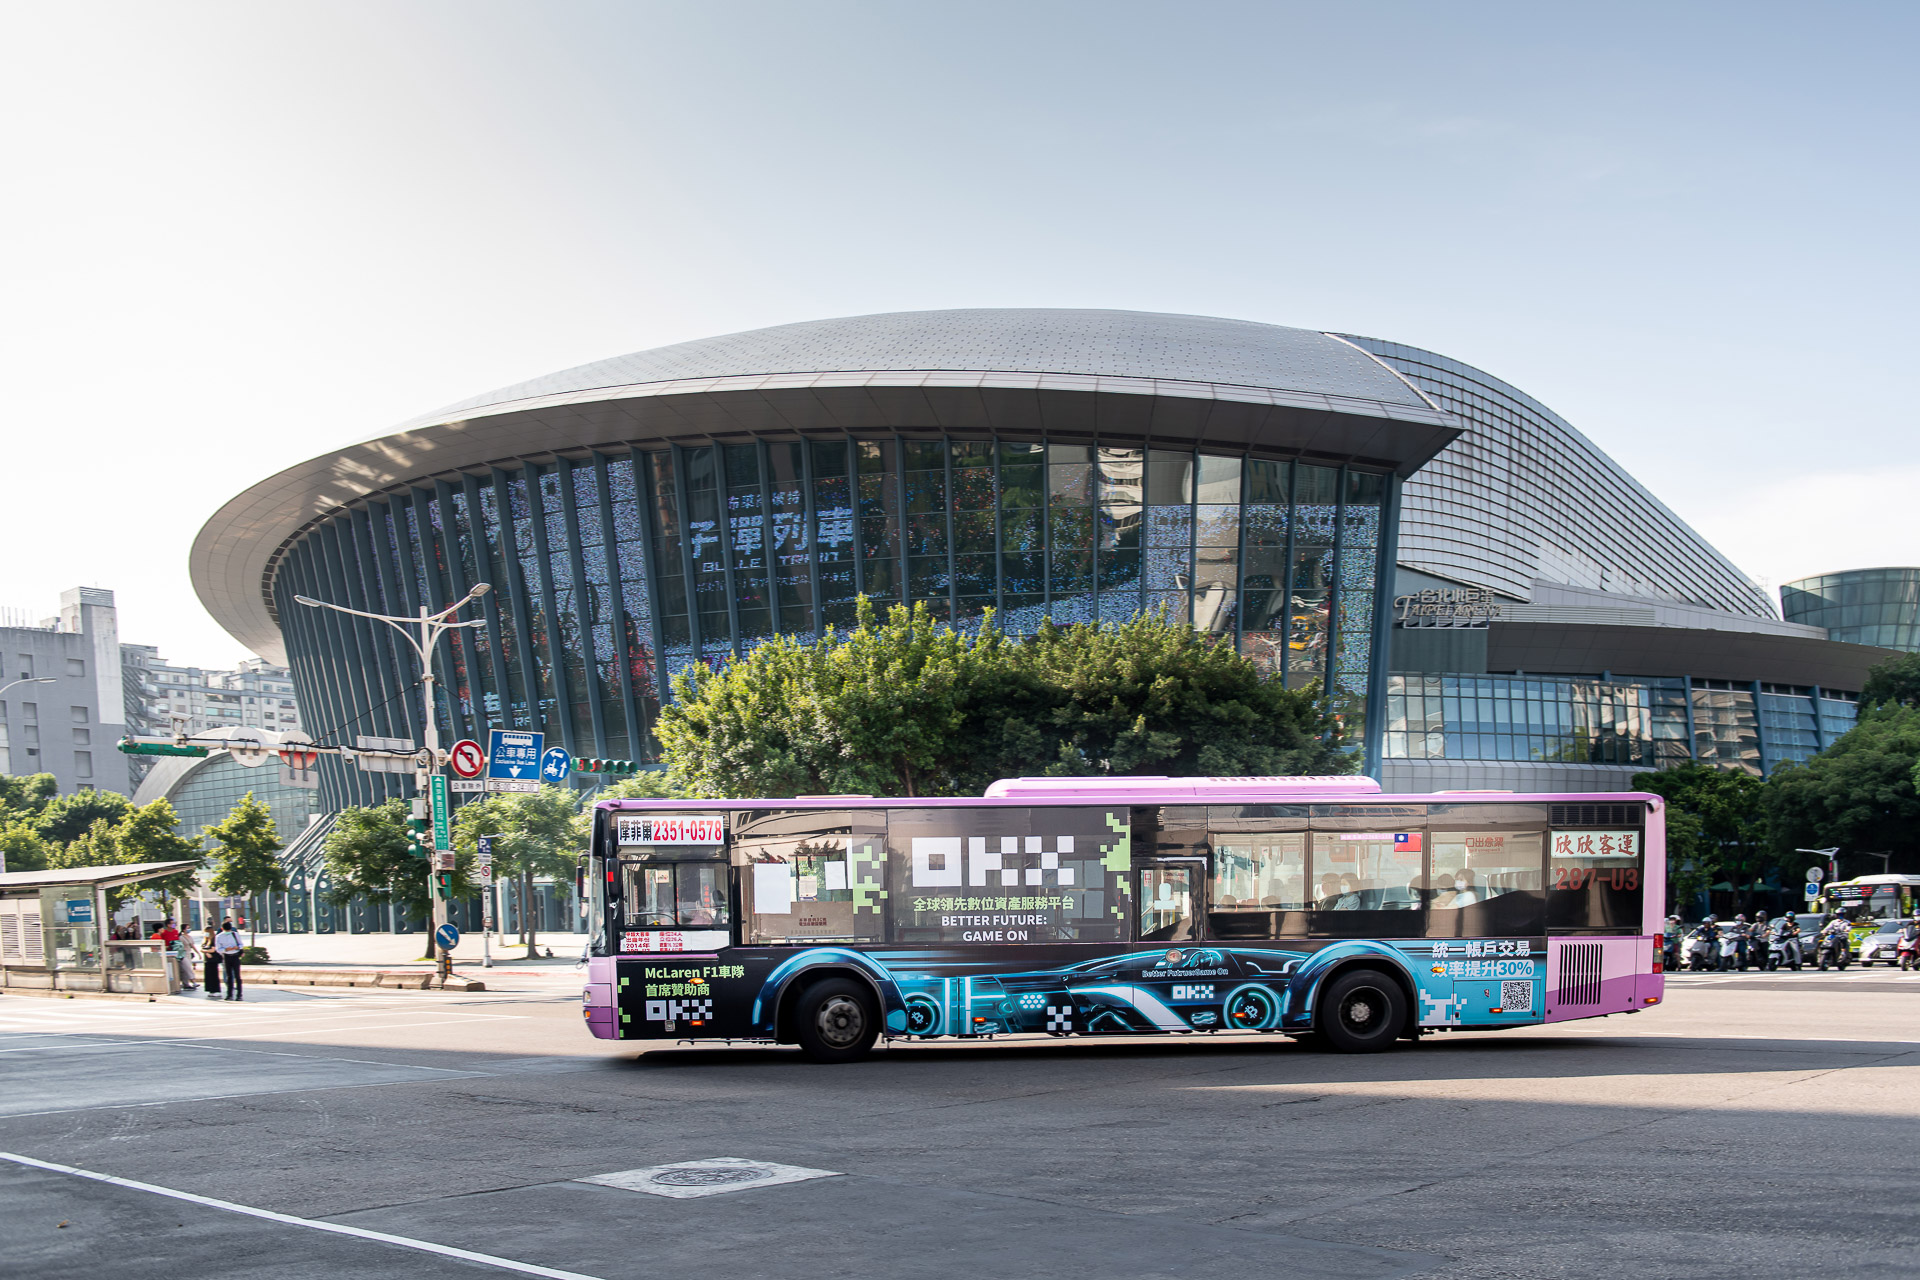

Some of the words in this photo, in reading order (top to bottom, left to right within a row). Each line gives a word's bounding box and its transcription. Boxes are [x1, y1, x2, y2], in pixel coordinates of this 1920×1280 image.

[495, 746, 537, 759] 公車專用
[1555, 834, 1635, 856] 欣欣客運
[912, 835, 1075, 887] OKX
[1556, 867, 1638, 891] 287-U3
[913, 896, 1075, 912] 全球領先數位資產服務平台
[941, 915, 990, 927] BETTER
[993, 914, 1048, 926] FUTURE:
[962, 930, 1003, 942] GAME
[1006, 930, 1028, 941] ON
[1432, 941, 1531, 958] 統一帳戶交易
[645, 967, 700, 979] McLaren
[703, 965, 745, 978] F1車隊
[645, 983, 710, 997] 首席贊助商
[1172, 985, 1214, 999] OKX
[645, 999, 713, 1021] OKX
